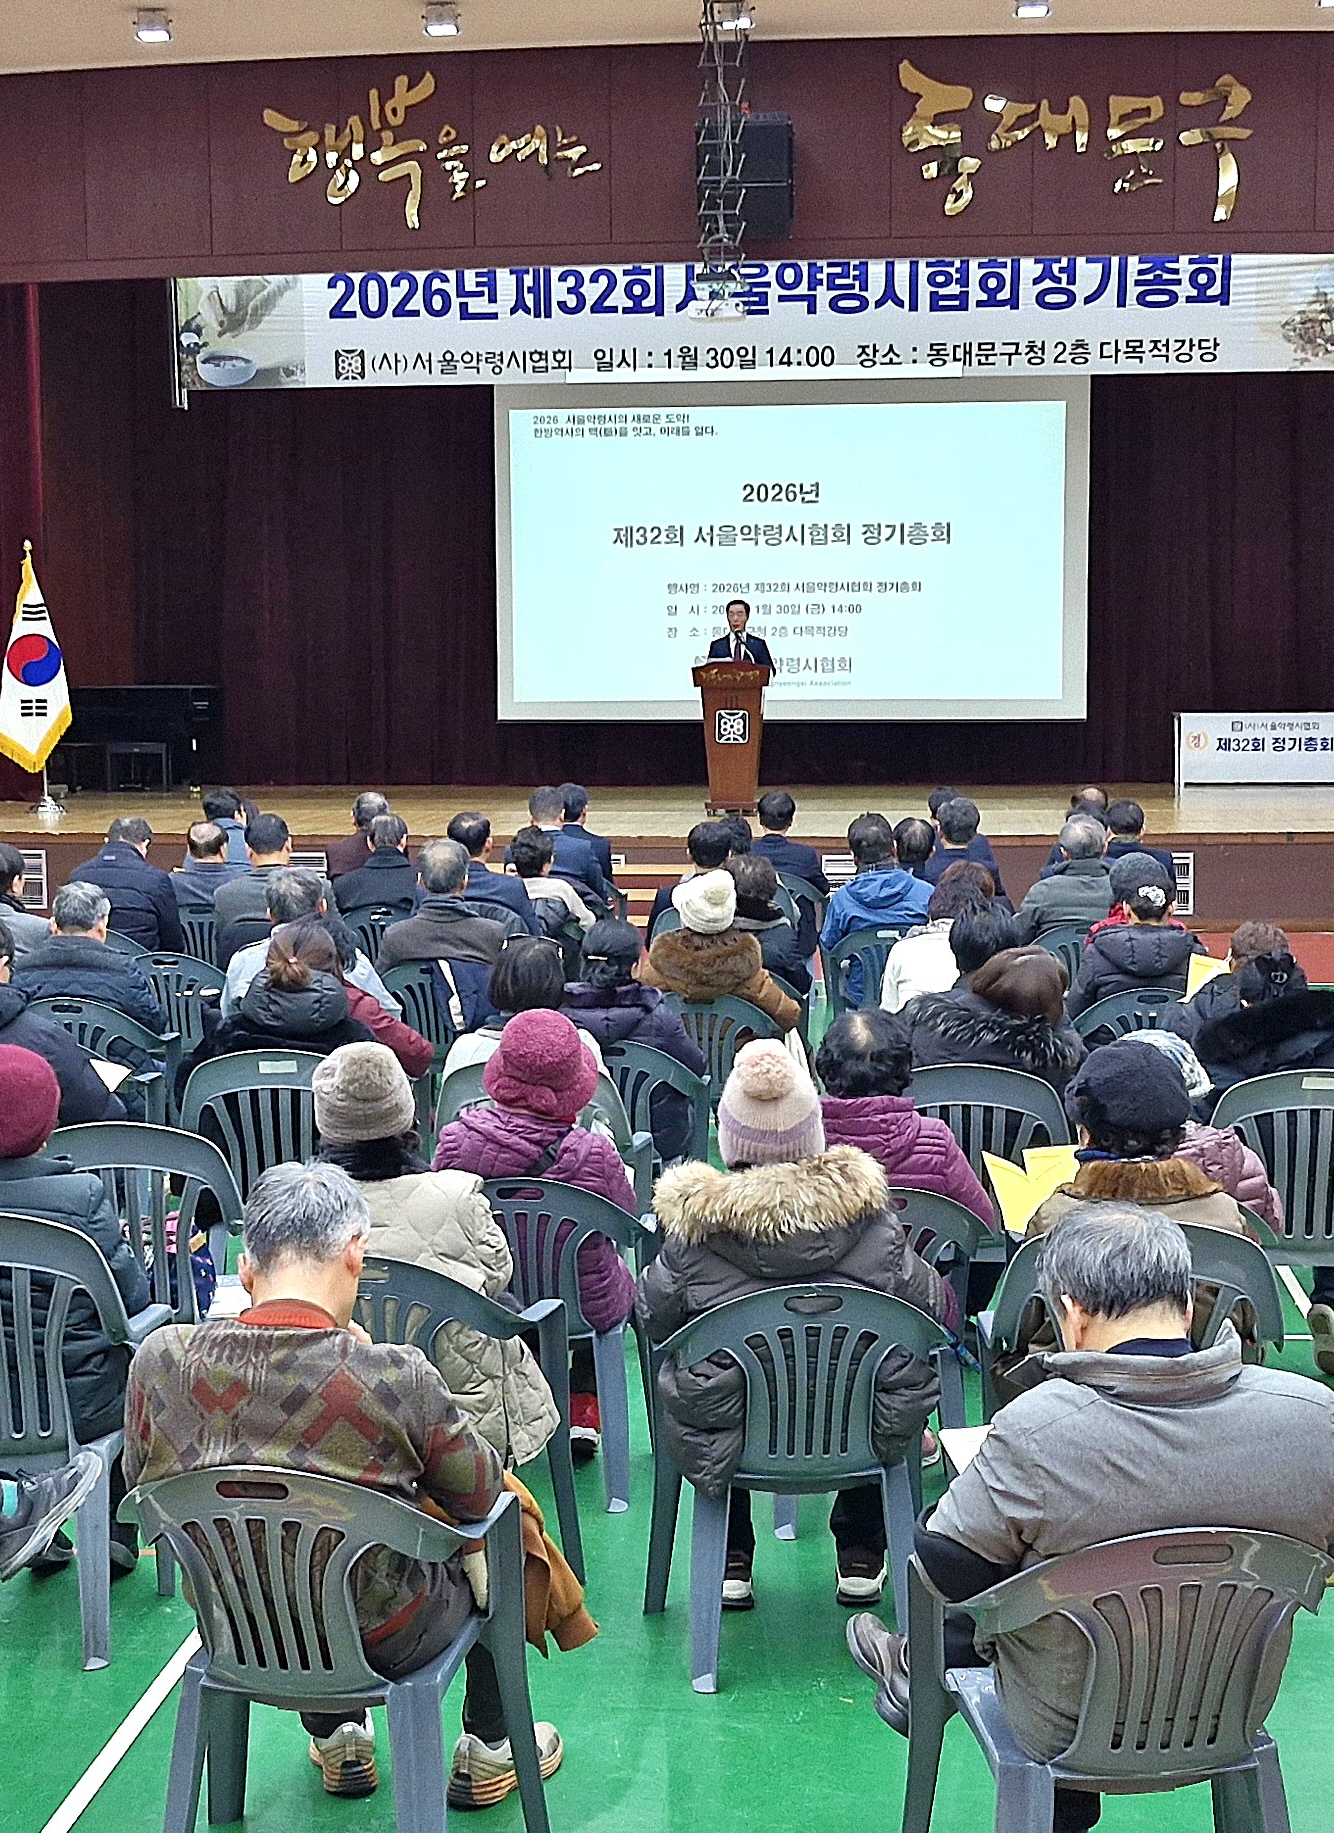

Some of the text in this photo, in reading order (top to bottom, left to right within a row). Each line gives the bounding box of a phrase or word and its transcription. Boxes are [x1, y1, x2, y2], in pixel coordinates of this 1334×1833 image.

[489, 125, 602, 179] 여는
[898, 58, 1254, 223] 동대문구
[327, 269, 499, 320] 2026년
[510, 265, 665, 318] 제32회
[1032, 255, 1233, 311] 정기총회
[594, 347, 638, 372] 일시
[663, 345, 699, 371] 1월
[705, 345, 757, 370] 30일
[766, 345, 835, 367] 14:00
[856, 343, 903, 367] 장소
[926, 339, 1046, 368] 동대문구청
[1053, 339, 1092, 365] 2층
[1099, 336, 1220, 364] 다목적강당
[533, 415, 559, 425] 2026
[742, 481, 820, 504] 2026년
[612, 521, 952, 548] 제32회 서울약령시협회 정기총회
[711, 582, 750, 594] 2026년
[754, 581, 790, 594] 제32회
[776, 604, 801, 615] 30일
[831, 603, 862, 614] 14:00
[1215, 736, 1334, 752] 제32회 정기총회
